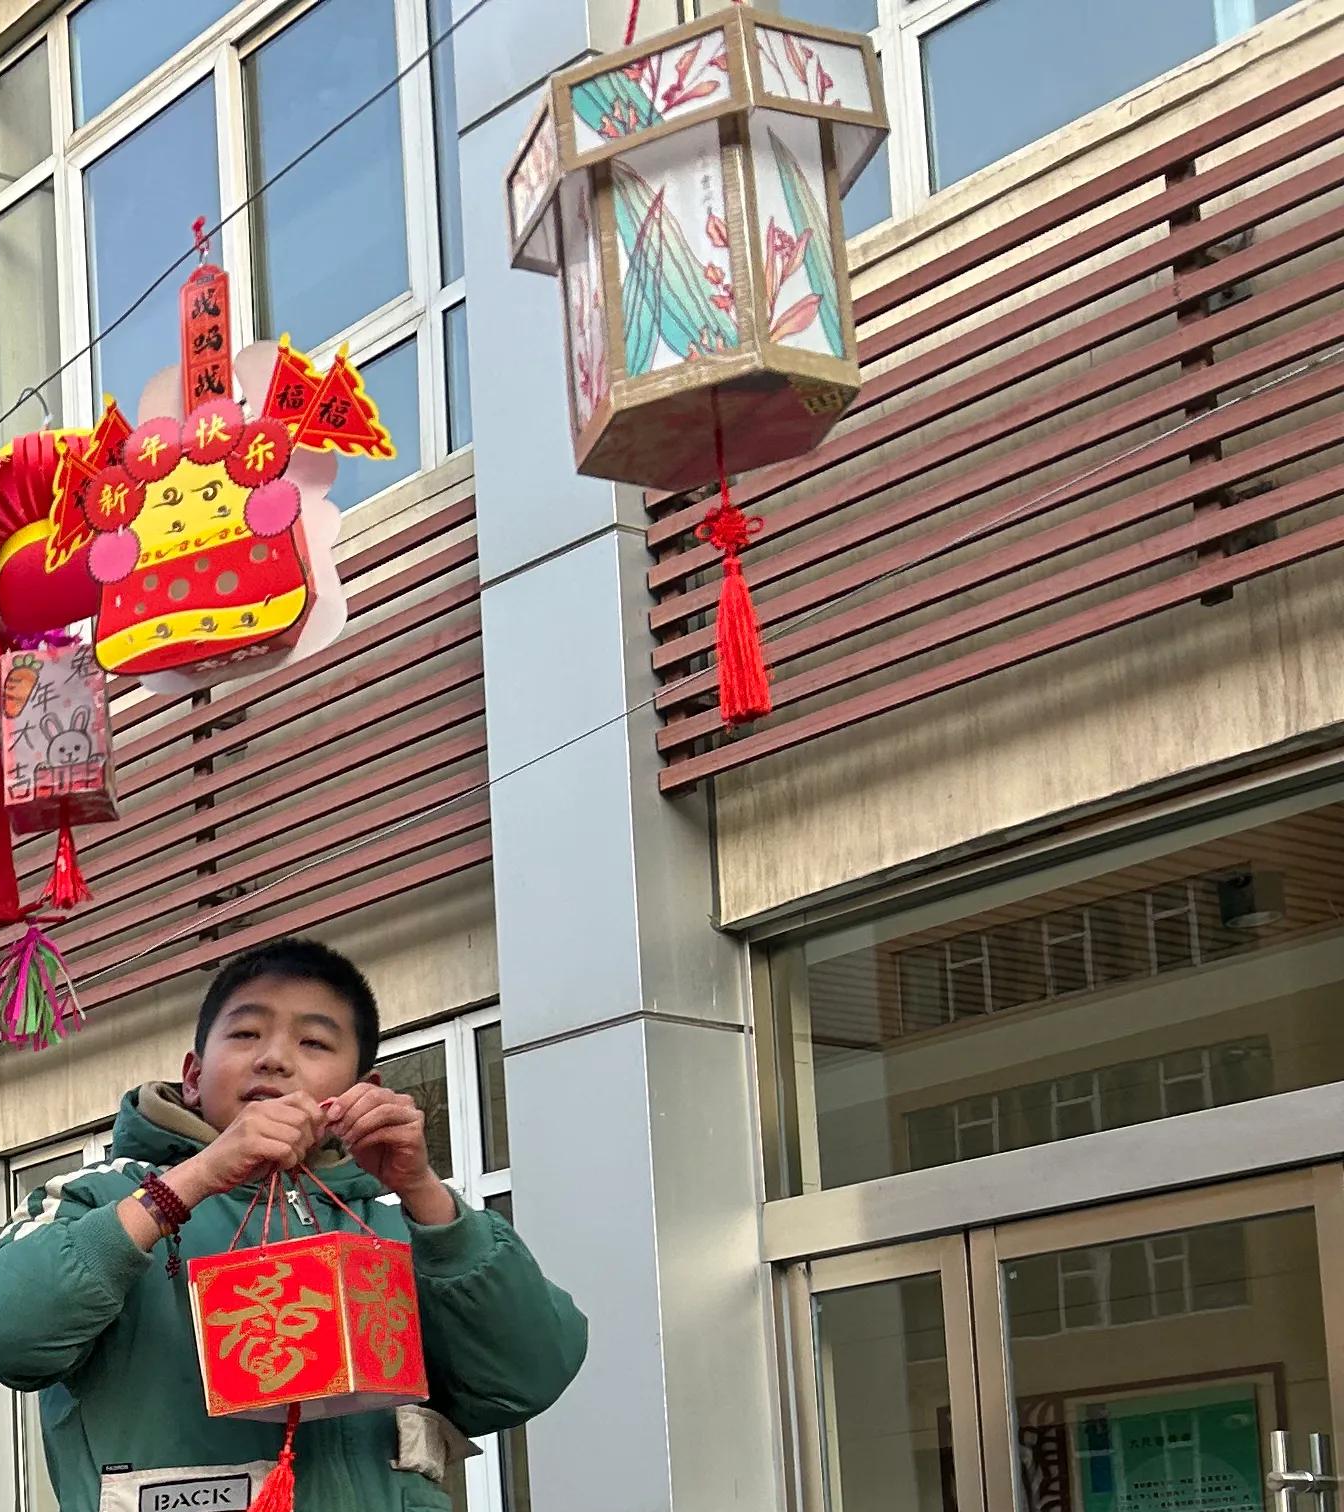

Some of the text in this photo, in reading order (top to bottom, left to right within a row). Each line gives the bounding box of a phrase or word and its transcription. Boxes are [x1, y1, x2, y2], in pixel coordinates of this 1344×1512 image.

[276, 384, 304, 411] 福
[319, 396, 351, 429] 福
[98, 415, 276, 517] 新年快乐
[154, 1487, 232, 1511] BACK
